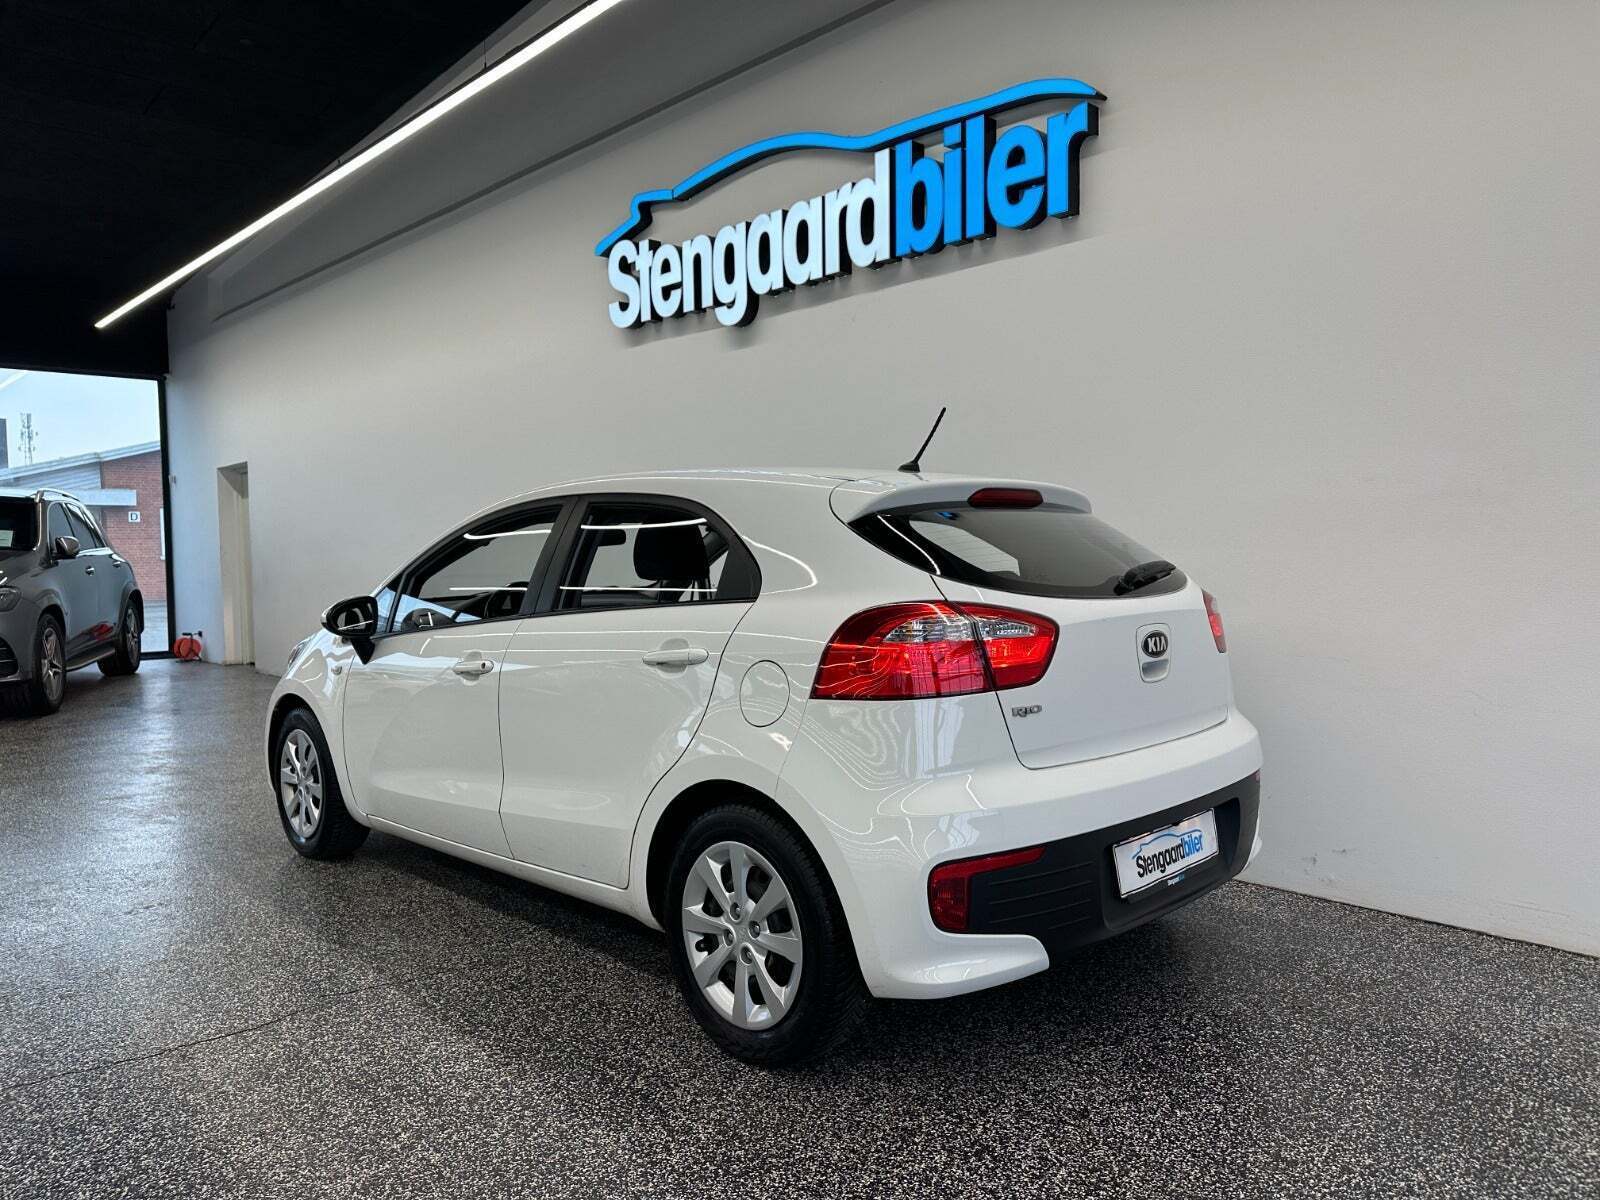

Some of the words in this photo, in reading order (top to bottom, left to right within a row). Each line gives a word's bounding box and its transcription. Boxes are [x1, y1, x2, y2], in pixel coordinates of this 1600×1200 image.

[608, 101, 1092, 329] Stengaardbiler
[130, 512, 138, 521] D
[1148, 637, 1167, 653] KIA
[1011, 705, 1042, 717] RIO
[1136, 834, 1203, 878] Stengaardbiler
